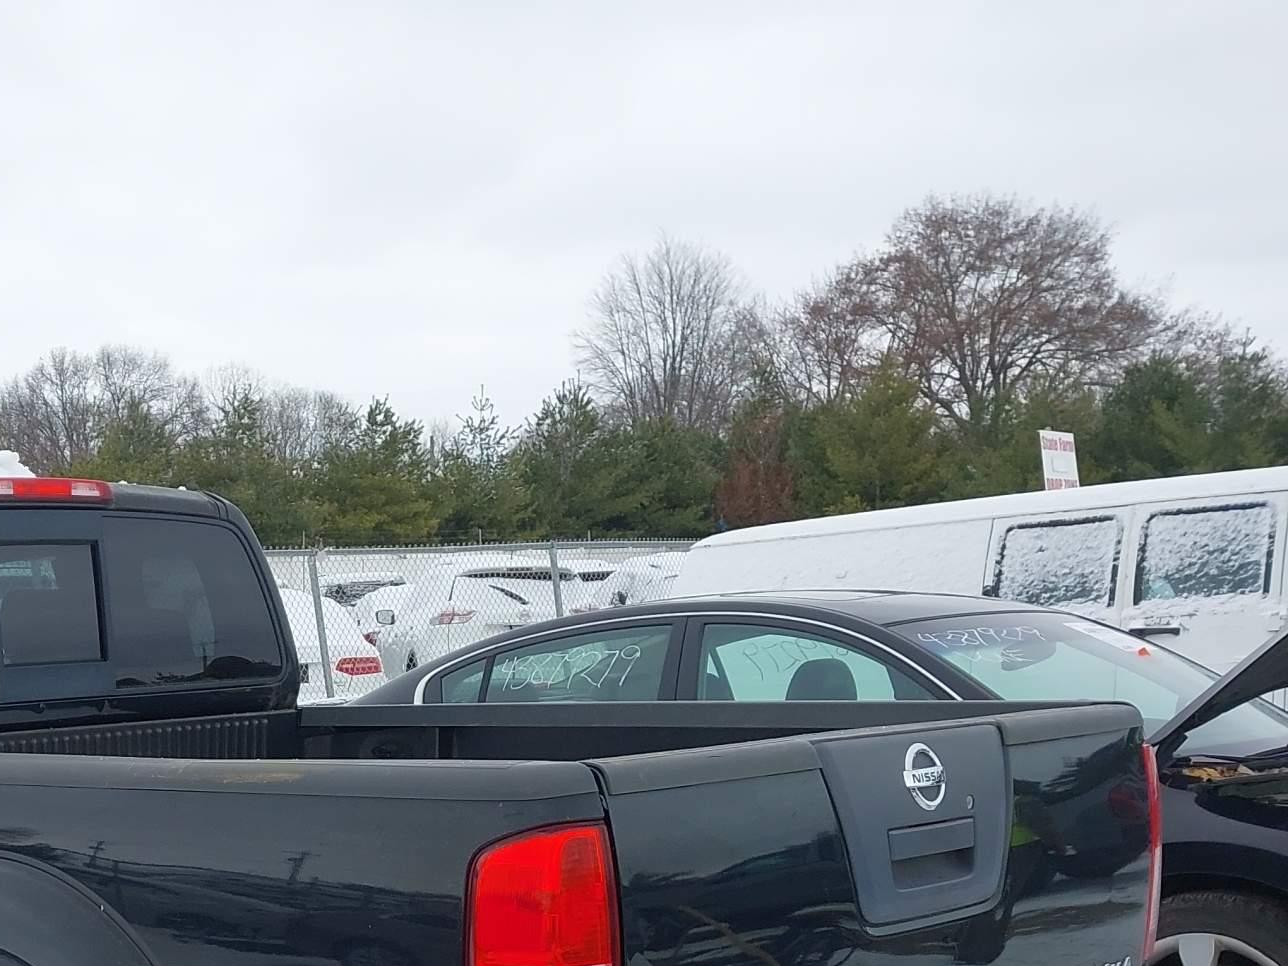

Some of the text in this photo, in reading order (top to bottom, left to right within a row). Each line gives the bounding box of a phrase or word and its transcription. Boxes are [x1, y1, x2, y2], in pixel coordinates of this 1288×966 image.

[1042, 436, 1074, 452] State Farm
[502, 645, 641, 691] 43879279
